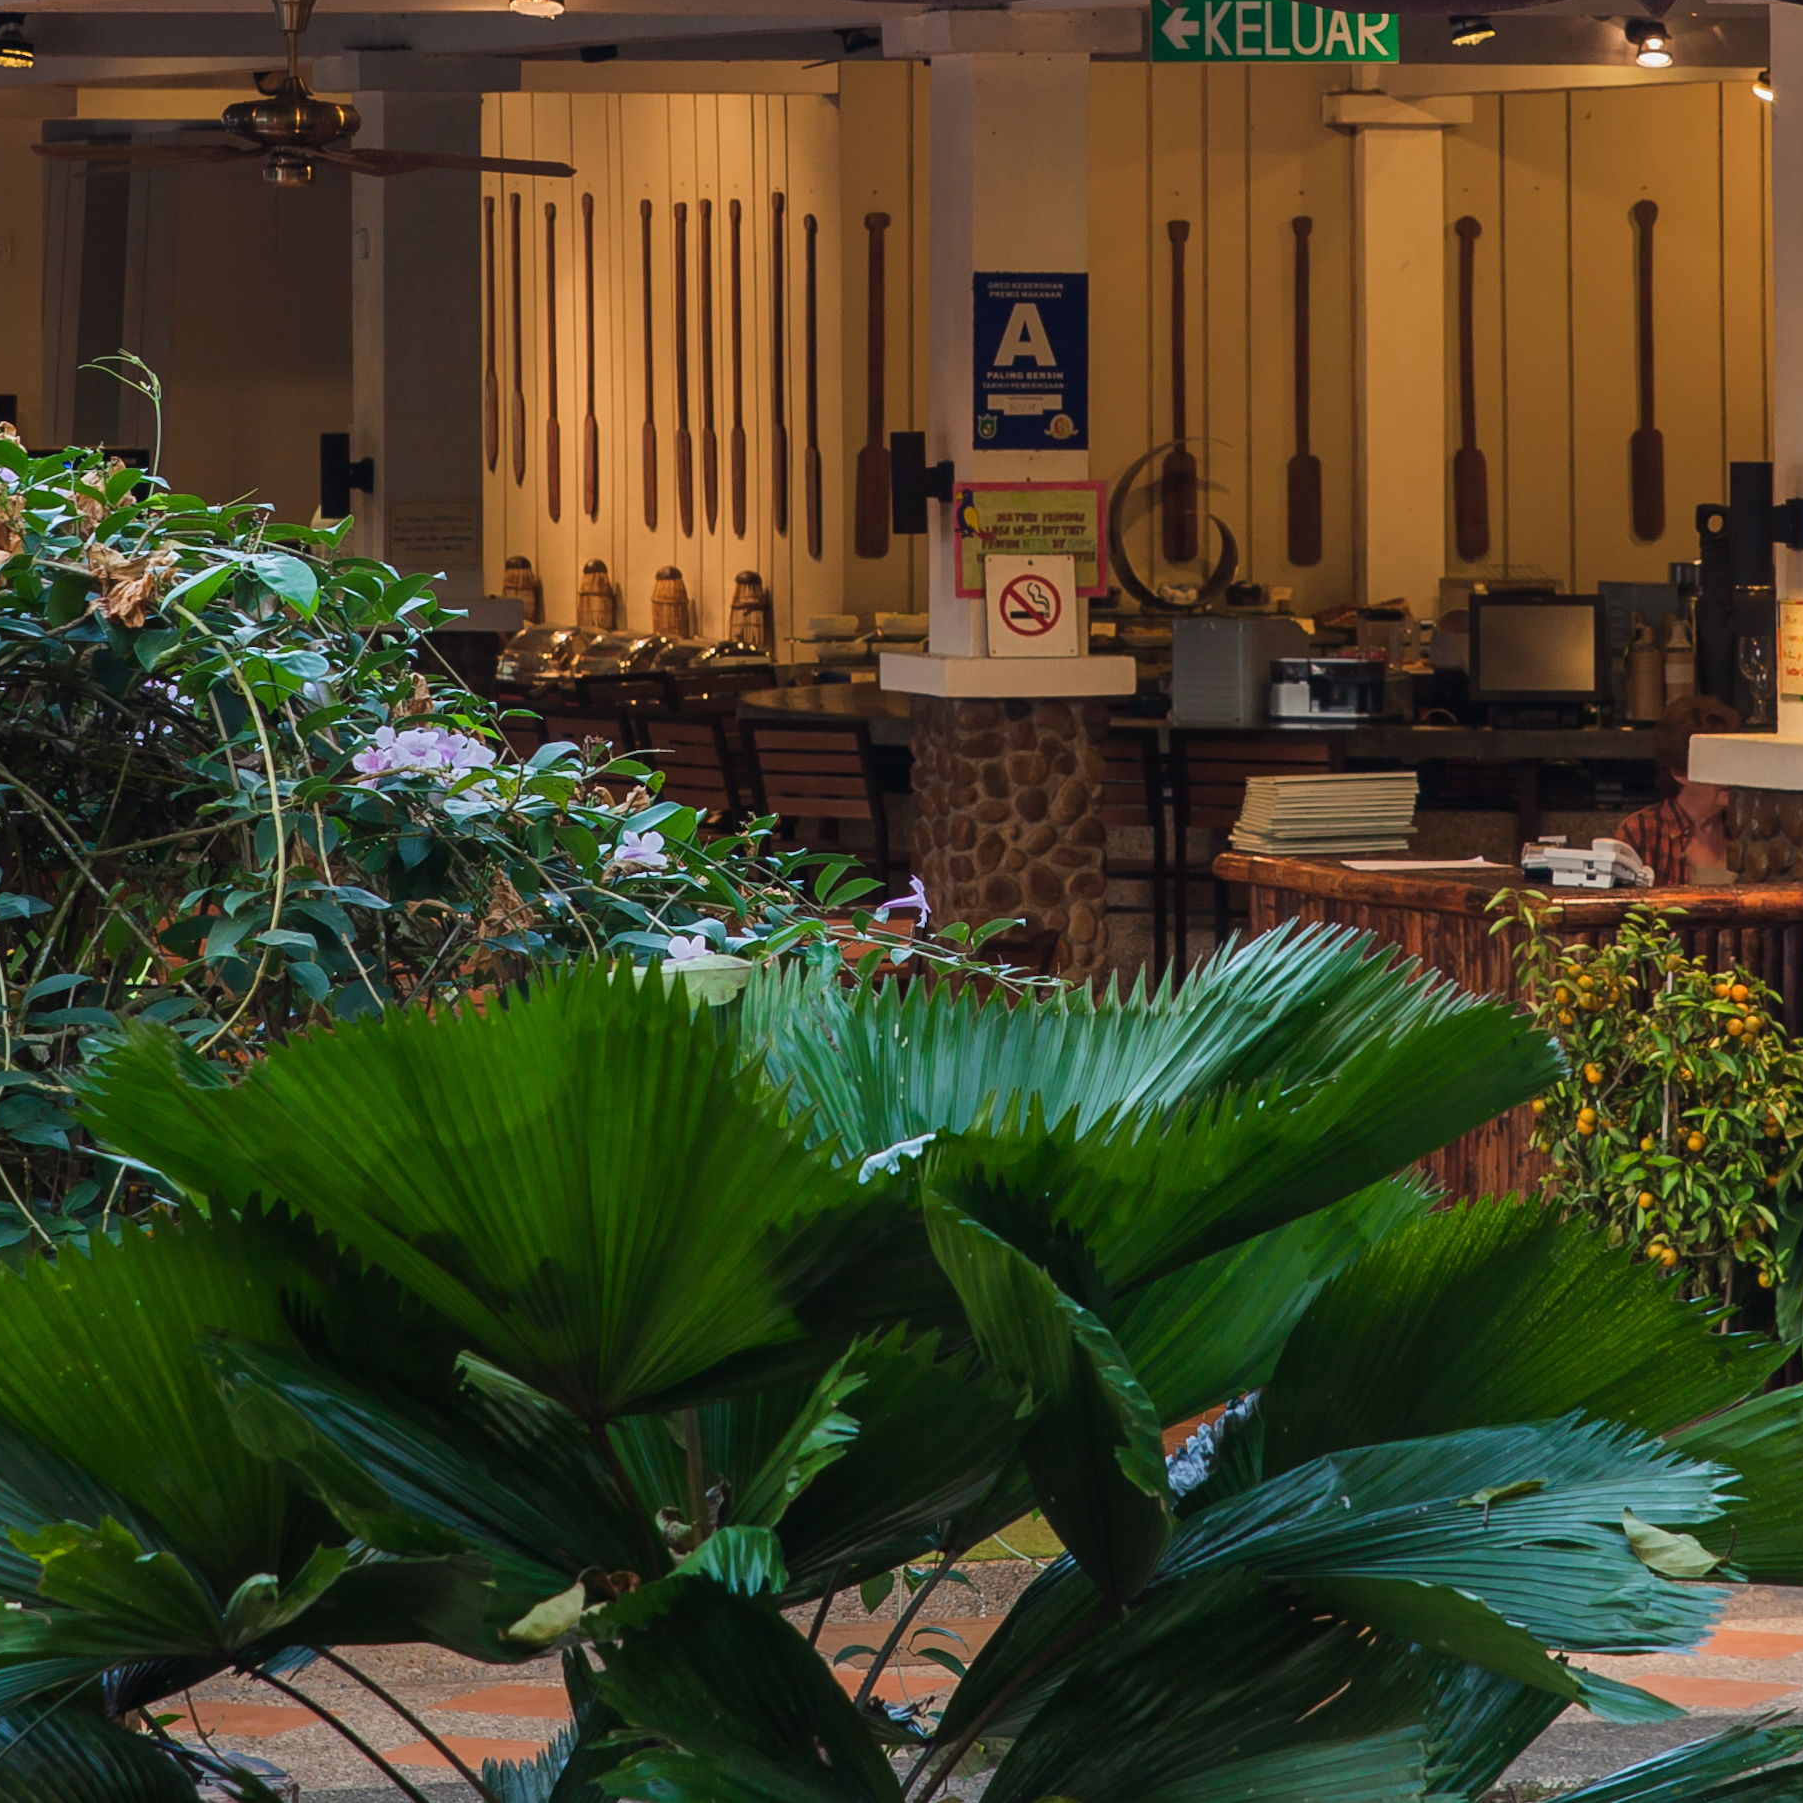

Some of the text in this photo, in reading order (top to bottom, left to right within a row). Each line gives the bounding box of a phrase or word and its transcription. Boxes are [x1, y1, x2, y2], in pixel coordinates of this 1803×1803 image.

[1204, 0, 1390, 57] KELUAR
[993, 302, 1057, 367] A
[987, 372, 1024, 380] PALING
